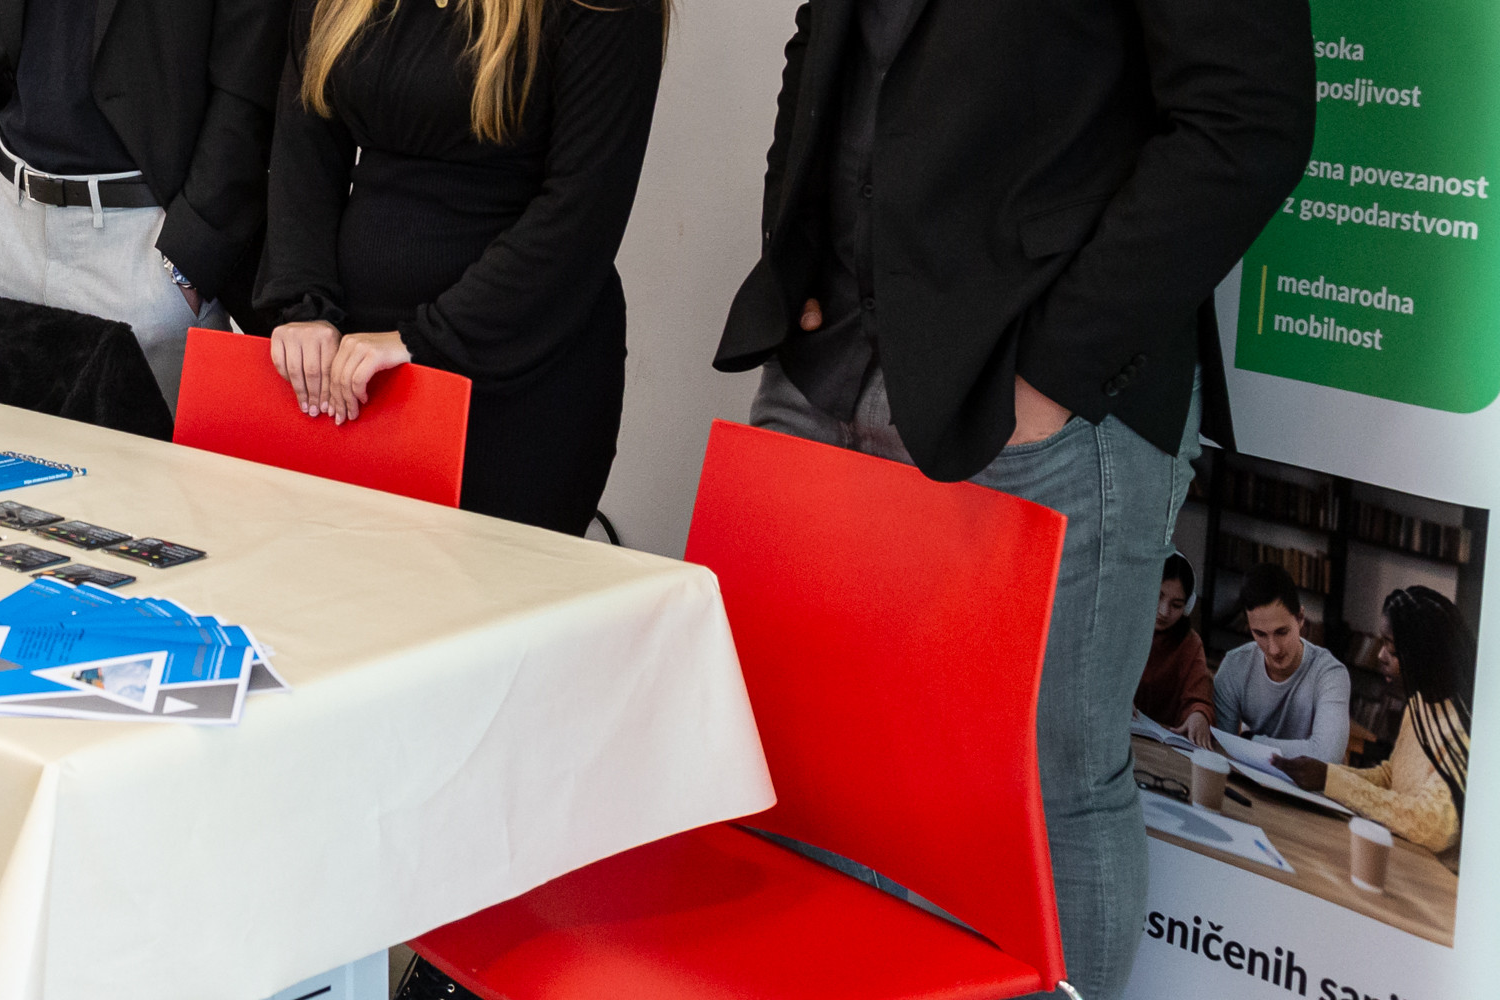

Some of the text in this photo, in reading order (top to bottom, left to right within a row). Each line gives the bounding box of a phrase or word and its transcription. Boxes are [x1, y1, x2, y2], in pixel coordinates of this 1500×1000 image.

[1312, 34, 1364, 61] soka
[1316, 78, 1421, 108] posljivost
[1304, 159, 1490, 199] sna povezanost
[1282, 197, 1478, 240] z gospodarstvom
[1277, 275, 1414, 316] mednarodna
[1274, 314, 1383, 351] mobilnost
[1144, 910, 1307, 997] sničenih
